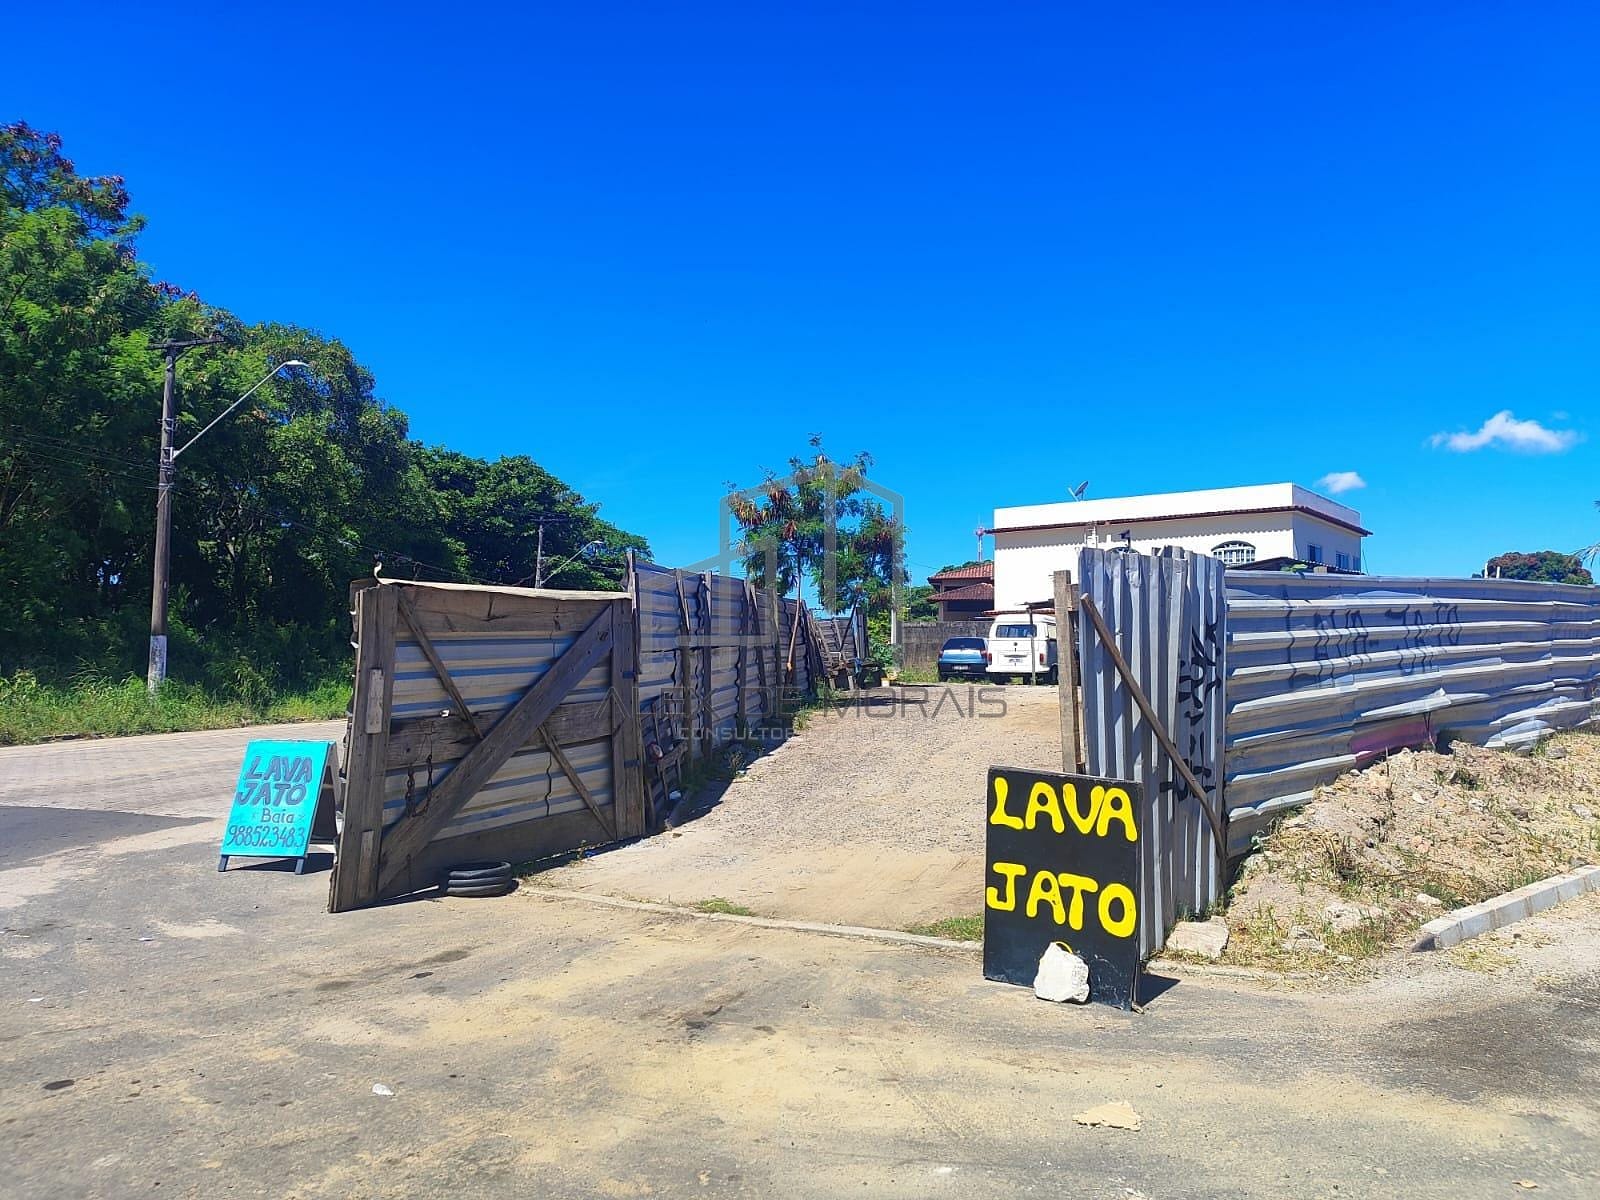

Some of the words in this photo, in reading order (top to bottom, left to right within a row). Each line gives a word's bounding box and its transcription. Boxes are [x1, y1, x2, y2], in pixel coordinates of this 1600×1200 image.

[245, 756, 313, 783] LAVA
[235, 782, 307, 806] JATO
[990, 777, 1138, 842] LAVA
[226, 825, 305, 848] 988523483
[986, 862, 1137, 938] JATO
